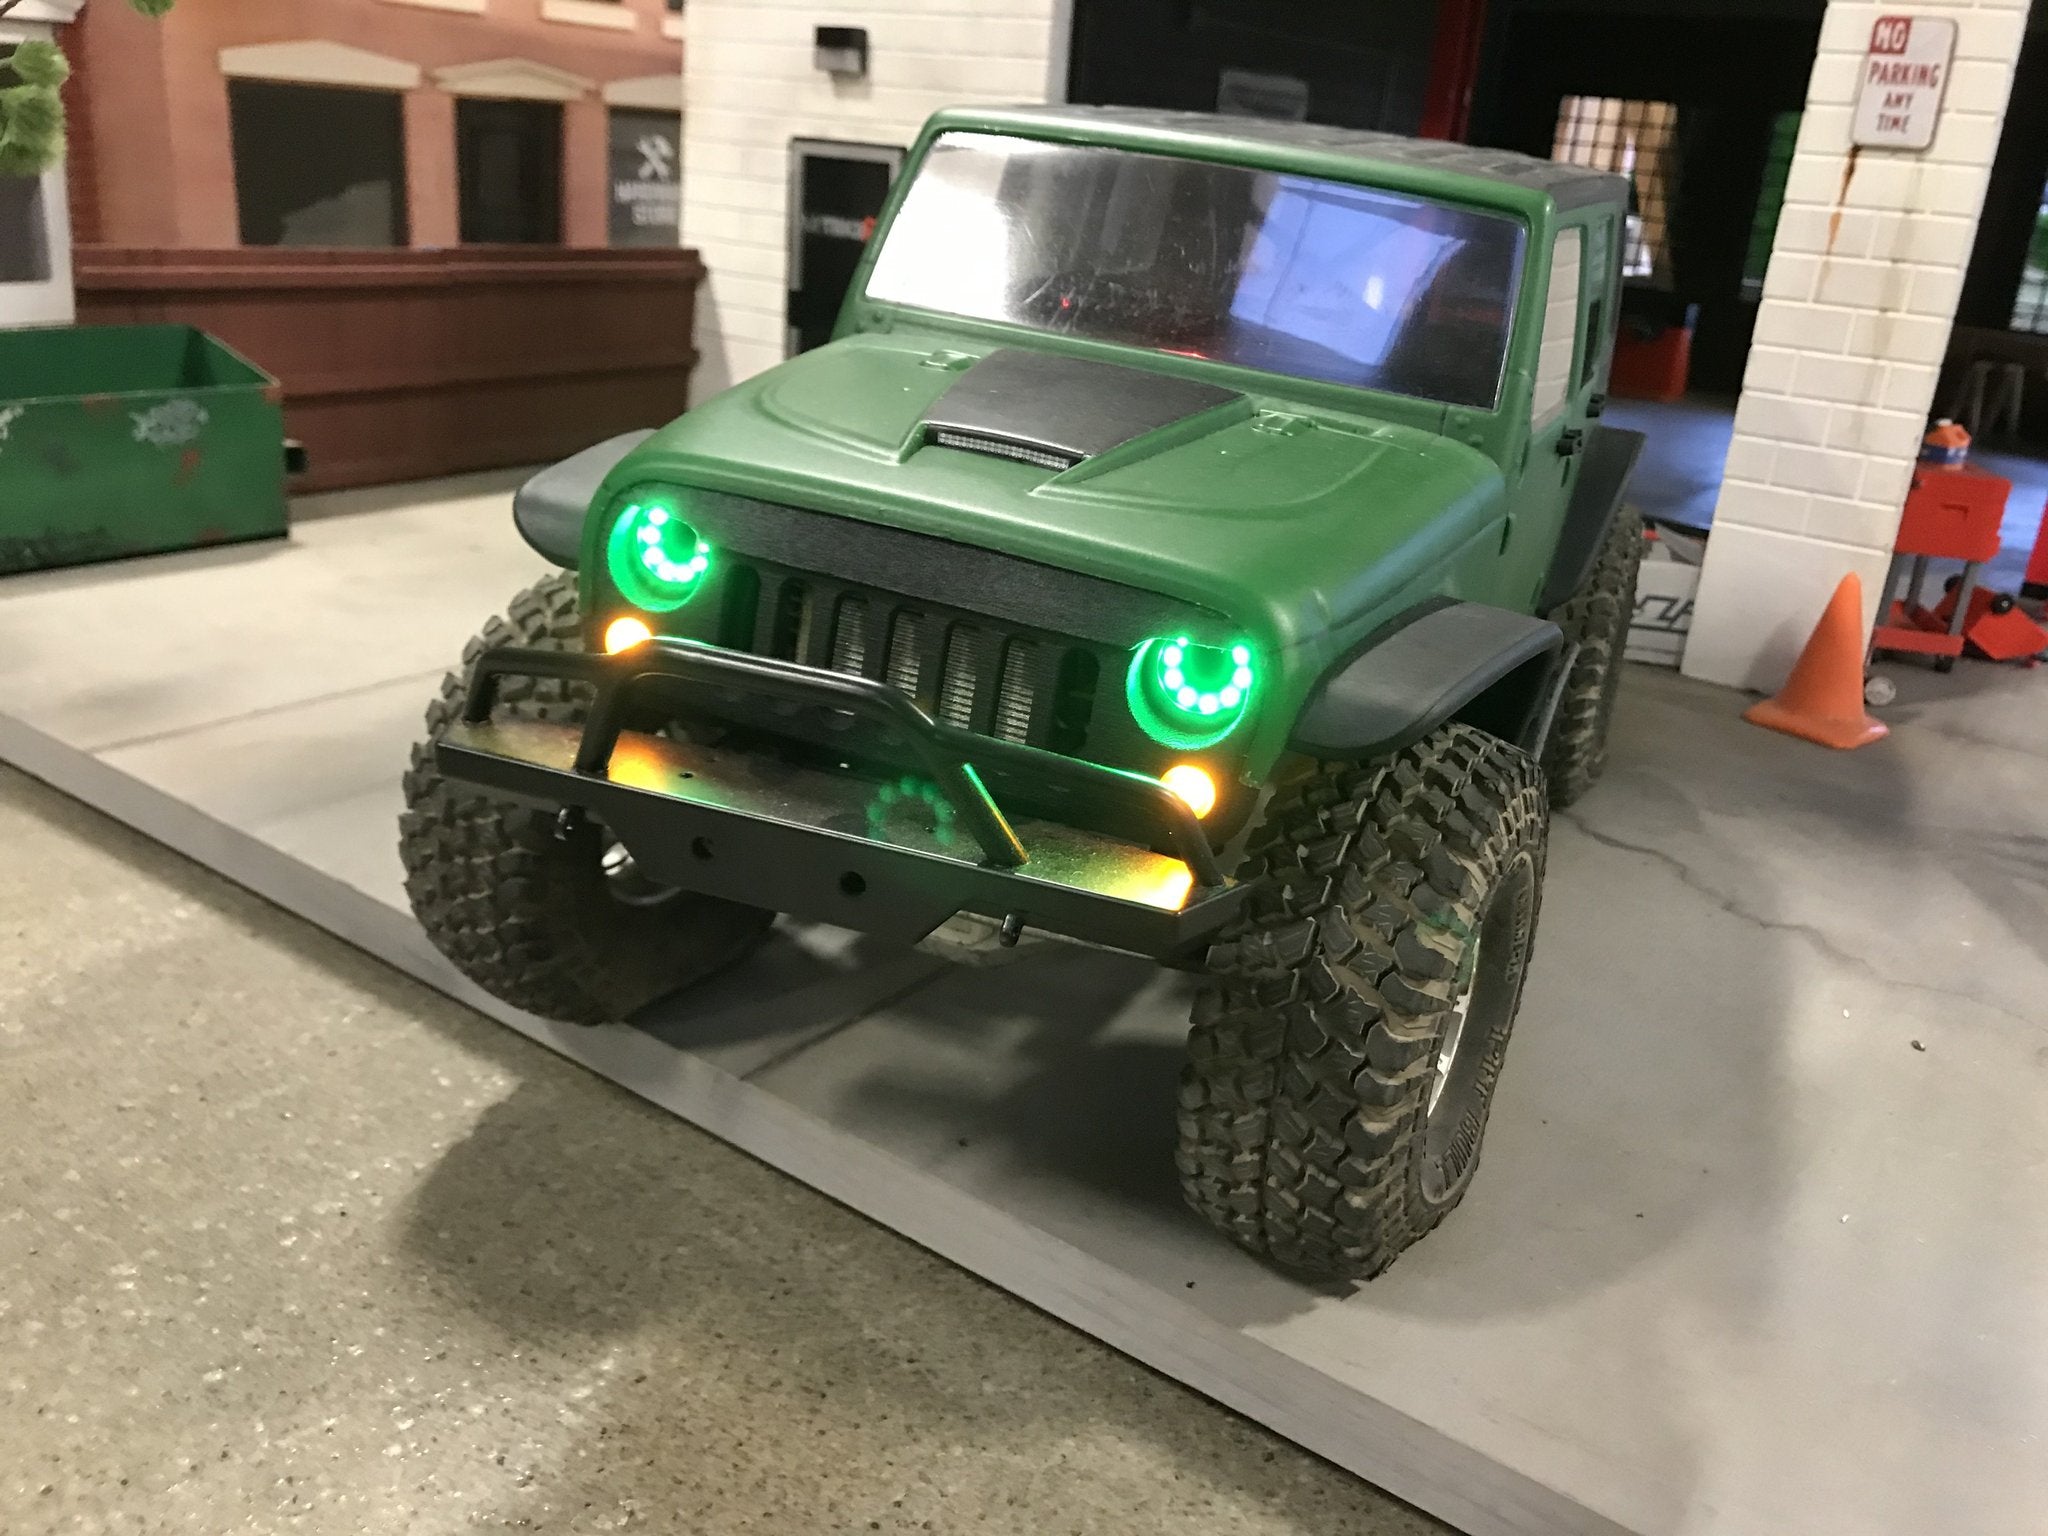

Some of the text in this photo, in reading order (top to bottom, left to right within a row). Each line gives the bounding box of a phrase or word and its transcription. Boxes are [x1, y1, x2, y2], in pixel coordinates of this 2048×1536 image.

[1875, 20, 1907, 50] NO
[1867, 61, 1940, 88] PARKING
[1882, 92, 1914, 110] ANY
[1876, 113, 1911, 133] TIME
